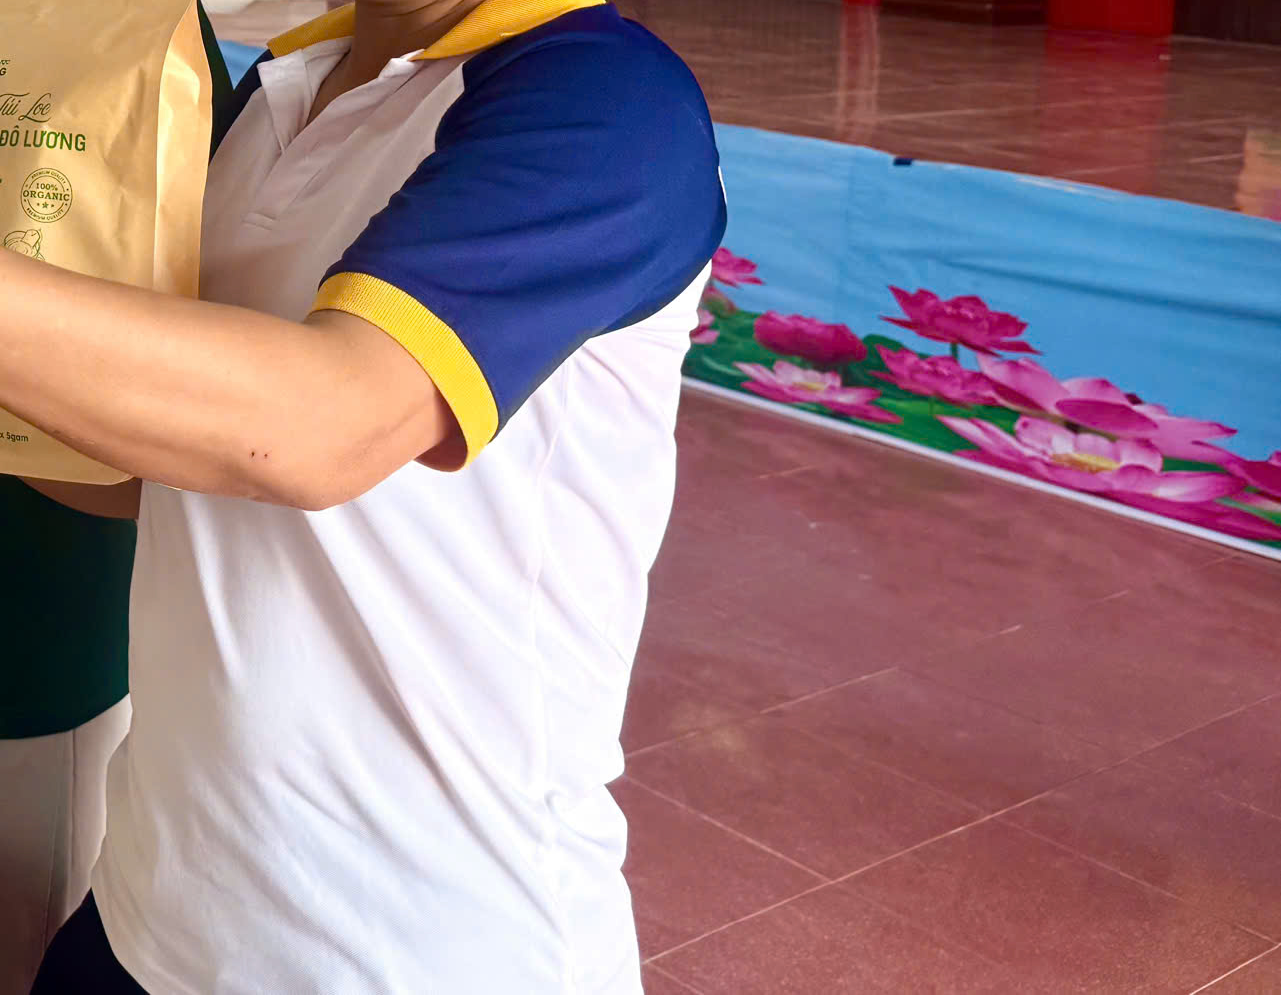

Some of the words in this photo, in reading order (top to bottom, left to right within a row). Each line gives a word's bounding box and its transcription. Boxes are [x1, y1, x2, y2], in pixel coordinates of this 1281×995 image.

[23, 129, 87, 152] LƯƠNG
[35, 182, 59, 191] 100%
[22, 189, 70, 202] ORGANIC
[6, 431, 29, 443] 5gam
